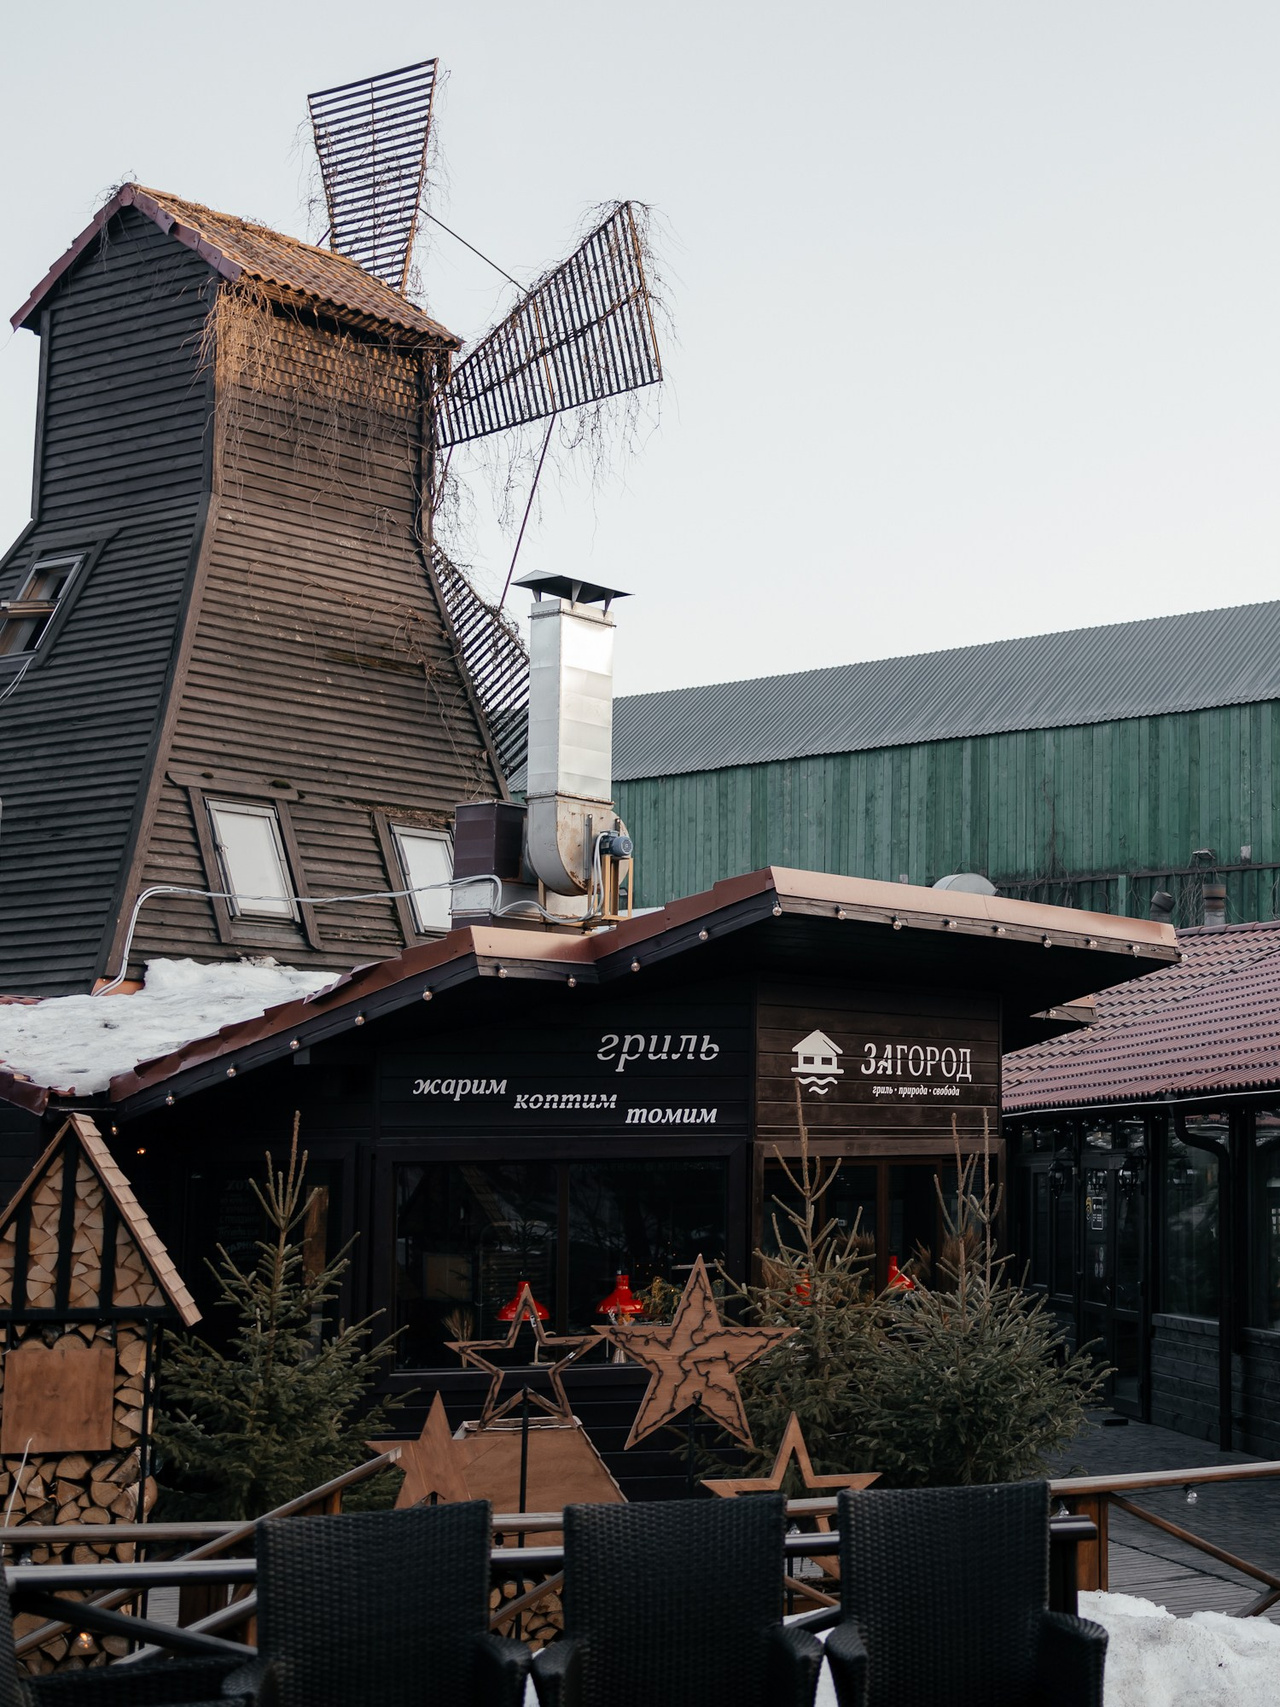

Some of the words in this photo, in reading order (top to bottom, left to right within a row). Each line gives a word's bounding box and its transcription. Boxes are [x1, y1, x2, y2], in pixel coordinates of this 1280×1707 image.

[597, 1035, 719, 1072] гриль
[861, 1043, 971, 1082] ЗАГОРОД
[413, 1080, 506, 1098] жарим
[872, 1085, 893, 1097] гриль
[898, 1085, 928, 1098] природа
[932, 1085, 961, 1096] свобода
[514, 1094, 617, 1108] коптим
[625, 1109, 717, 1123] томим
